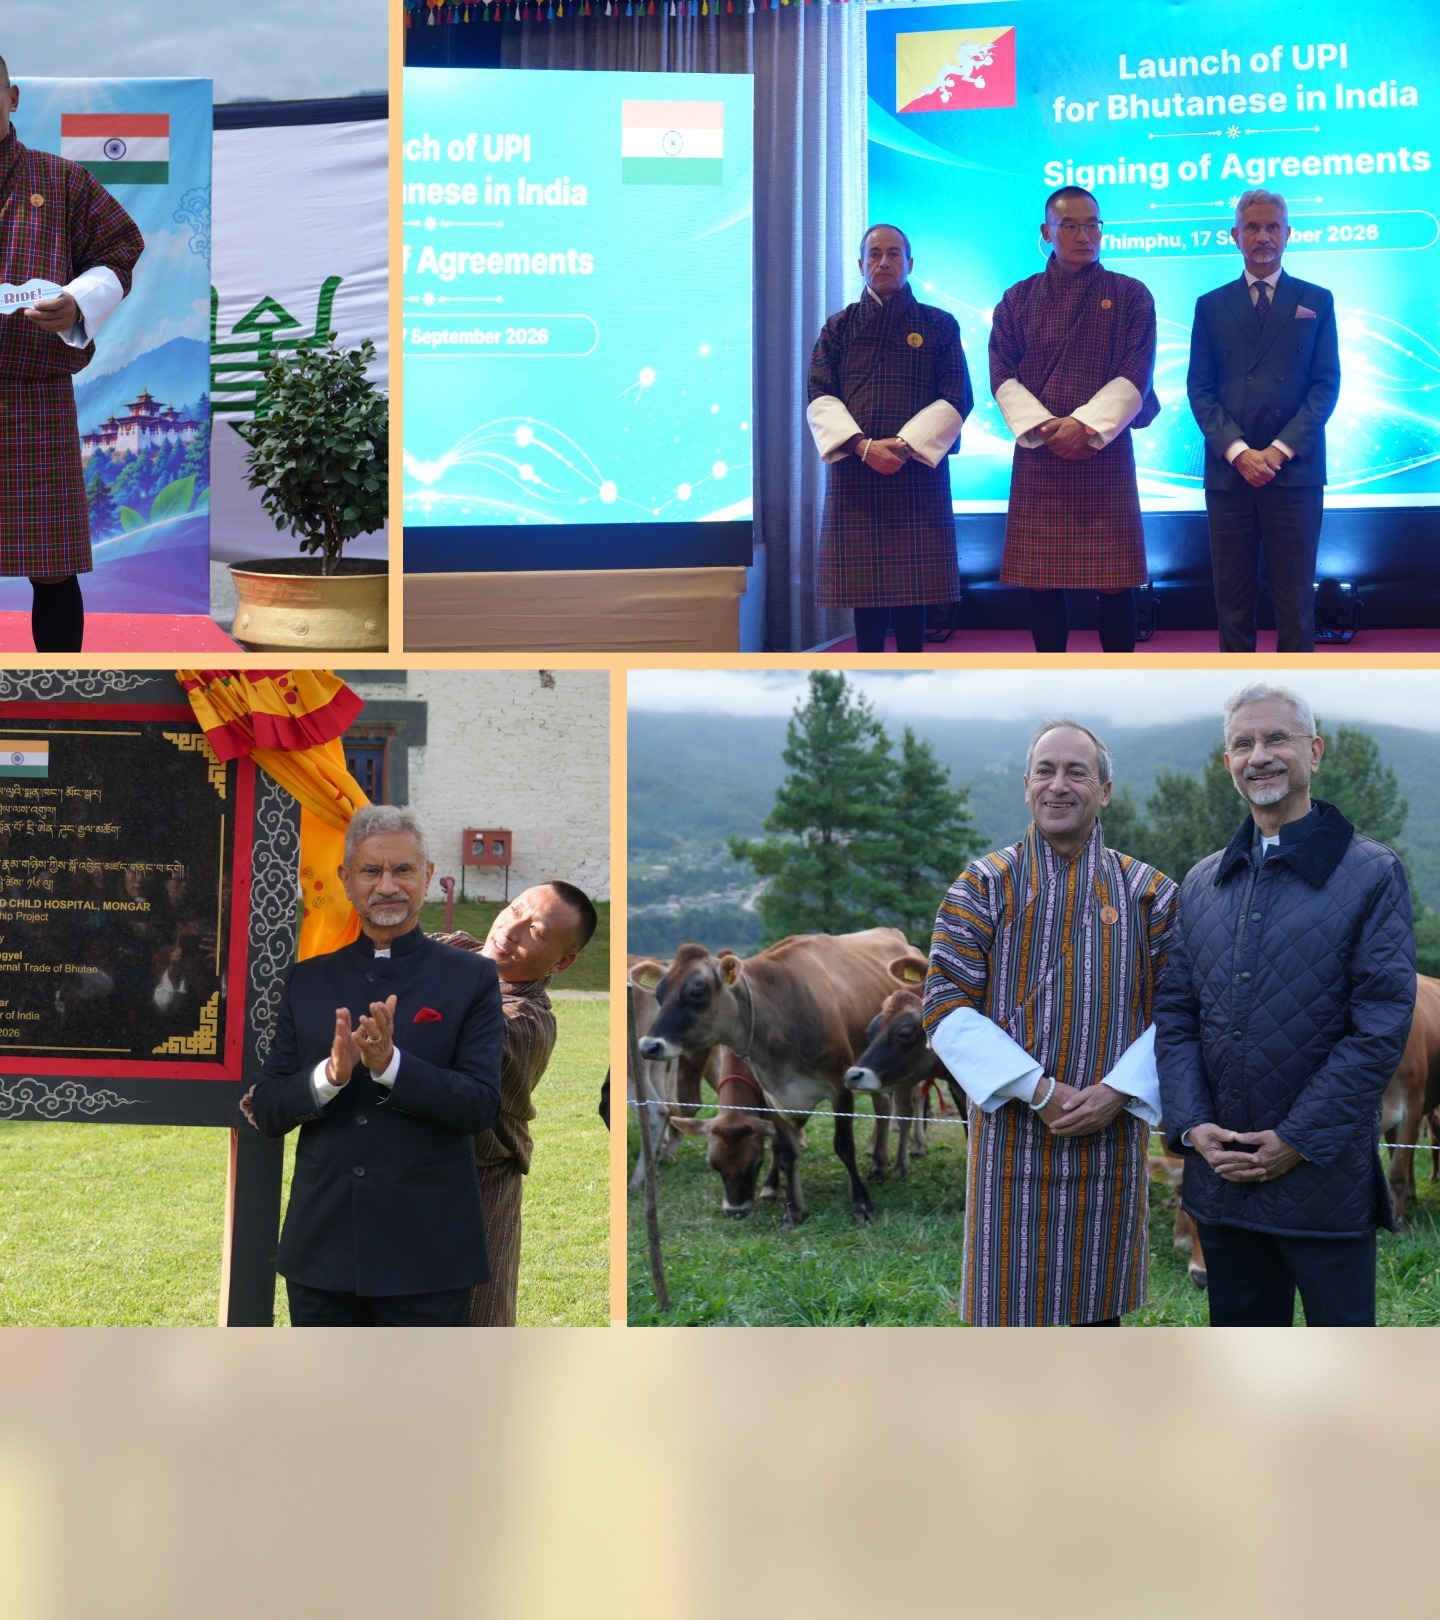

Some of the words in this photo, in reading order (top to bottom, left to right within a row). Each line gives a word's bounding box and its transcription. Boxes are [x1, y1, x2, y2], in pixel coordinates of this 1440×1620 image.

[1118, 49, 1241, 80] Launch
[1249, 45, 1284, 73] of
[1291, 42, 1348, 71] UPI
[1052, 96, 1099, 123] for
[1107, 91, 1288, 121] Bhutanese
[1295, 83, 1326, 111] in
[1335, 79, 1419, 109] India
[447, 132, 478, 162] of
[483, 133, 531, 163] UPI
[1043, 156, 1169, 192] Signing
[1178, 153, 1212, 181] of
[1220, 147, 1431, 187] Agreements
[485, 175, 511, 206] in
[517, 175, 587, 206] India
[1190, 230, 1212, 247] 17
[1326, 224, 1379, 242] 2026
[416, 245, 595, 281] Agreements
[4, 288, 42, 304] RIDE!
[410, 327, 503, 349] September
[505, 327, 549, 345] 2026
[9, 899, 41, 909] CHILD
[44, 900, 100, 911] HOSPITAL,
[103, 901, 151, 912] MONGAR
[16, 911, 49, 923] Project
[23, 963, 51, 973] Trade
[53, 963, 63, 973] of
[64, 964, 98, 974] Bhutan
[5, 1010, 16, 1019] of
[17, 1011, 40, 1021] India
